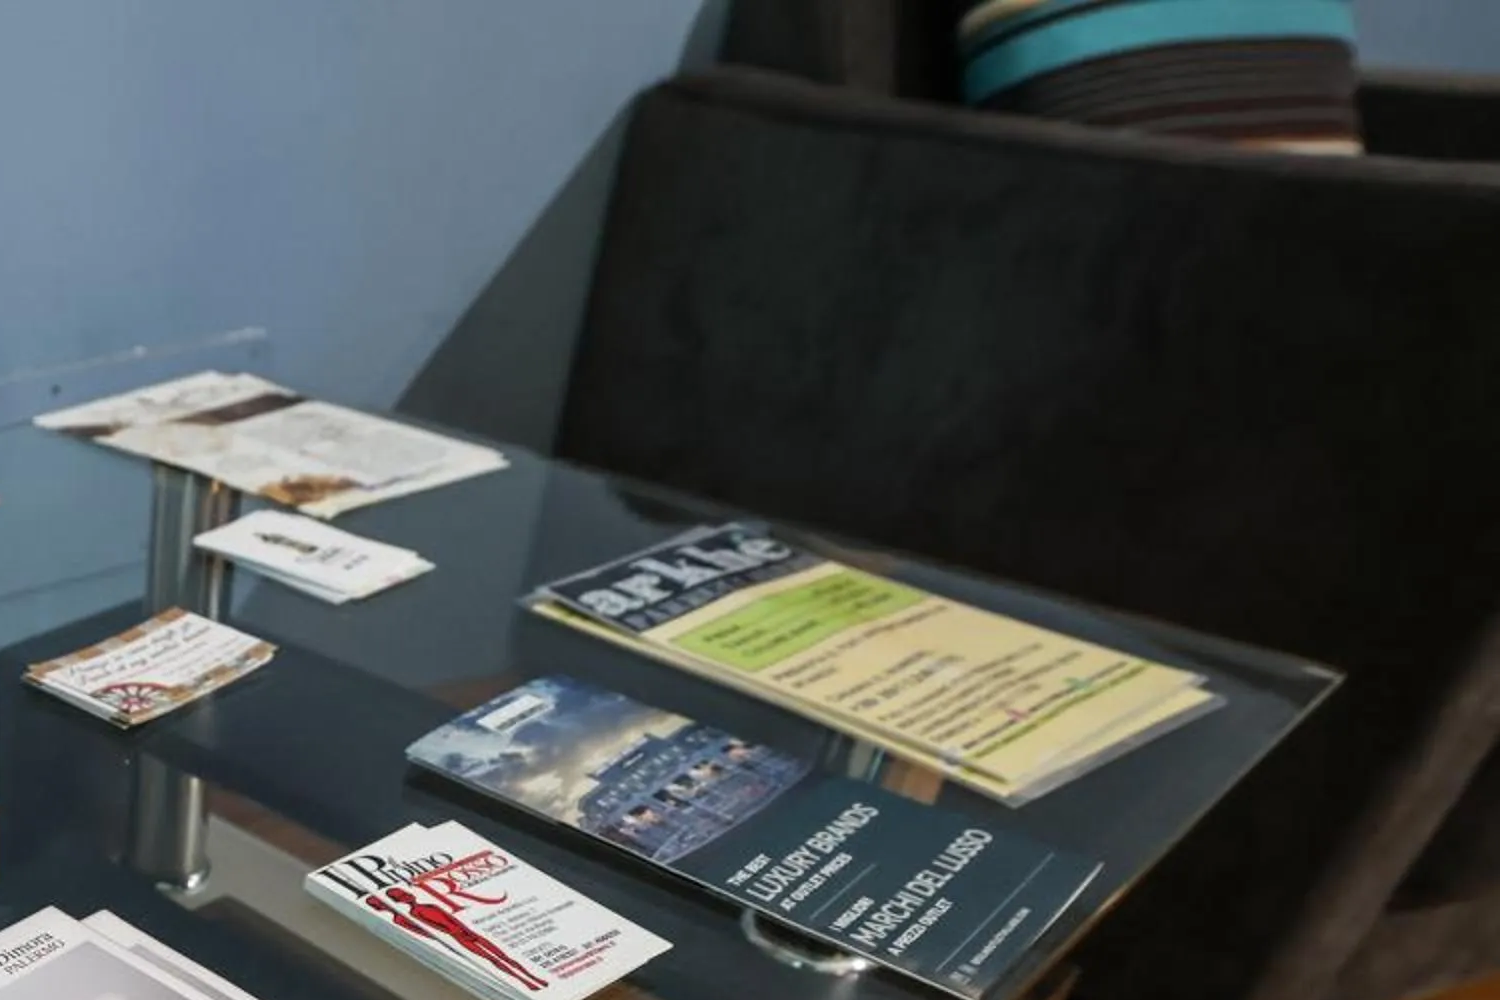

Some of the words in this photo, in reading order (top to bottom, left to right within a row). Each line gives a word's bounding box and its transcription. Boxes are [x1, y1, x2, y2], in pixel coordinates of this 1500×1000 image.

[746, 844, 821, 903] LUXURY
[807, 802, 880, 854] BRANDS
[849, 889, 920, 949] MARCHI
[913, 860, 951, 899] DEL
[937, 827, 995, 875] LUSSO
[3, 939, 66, 976] PALERMO
